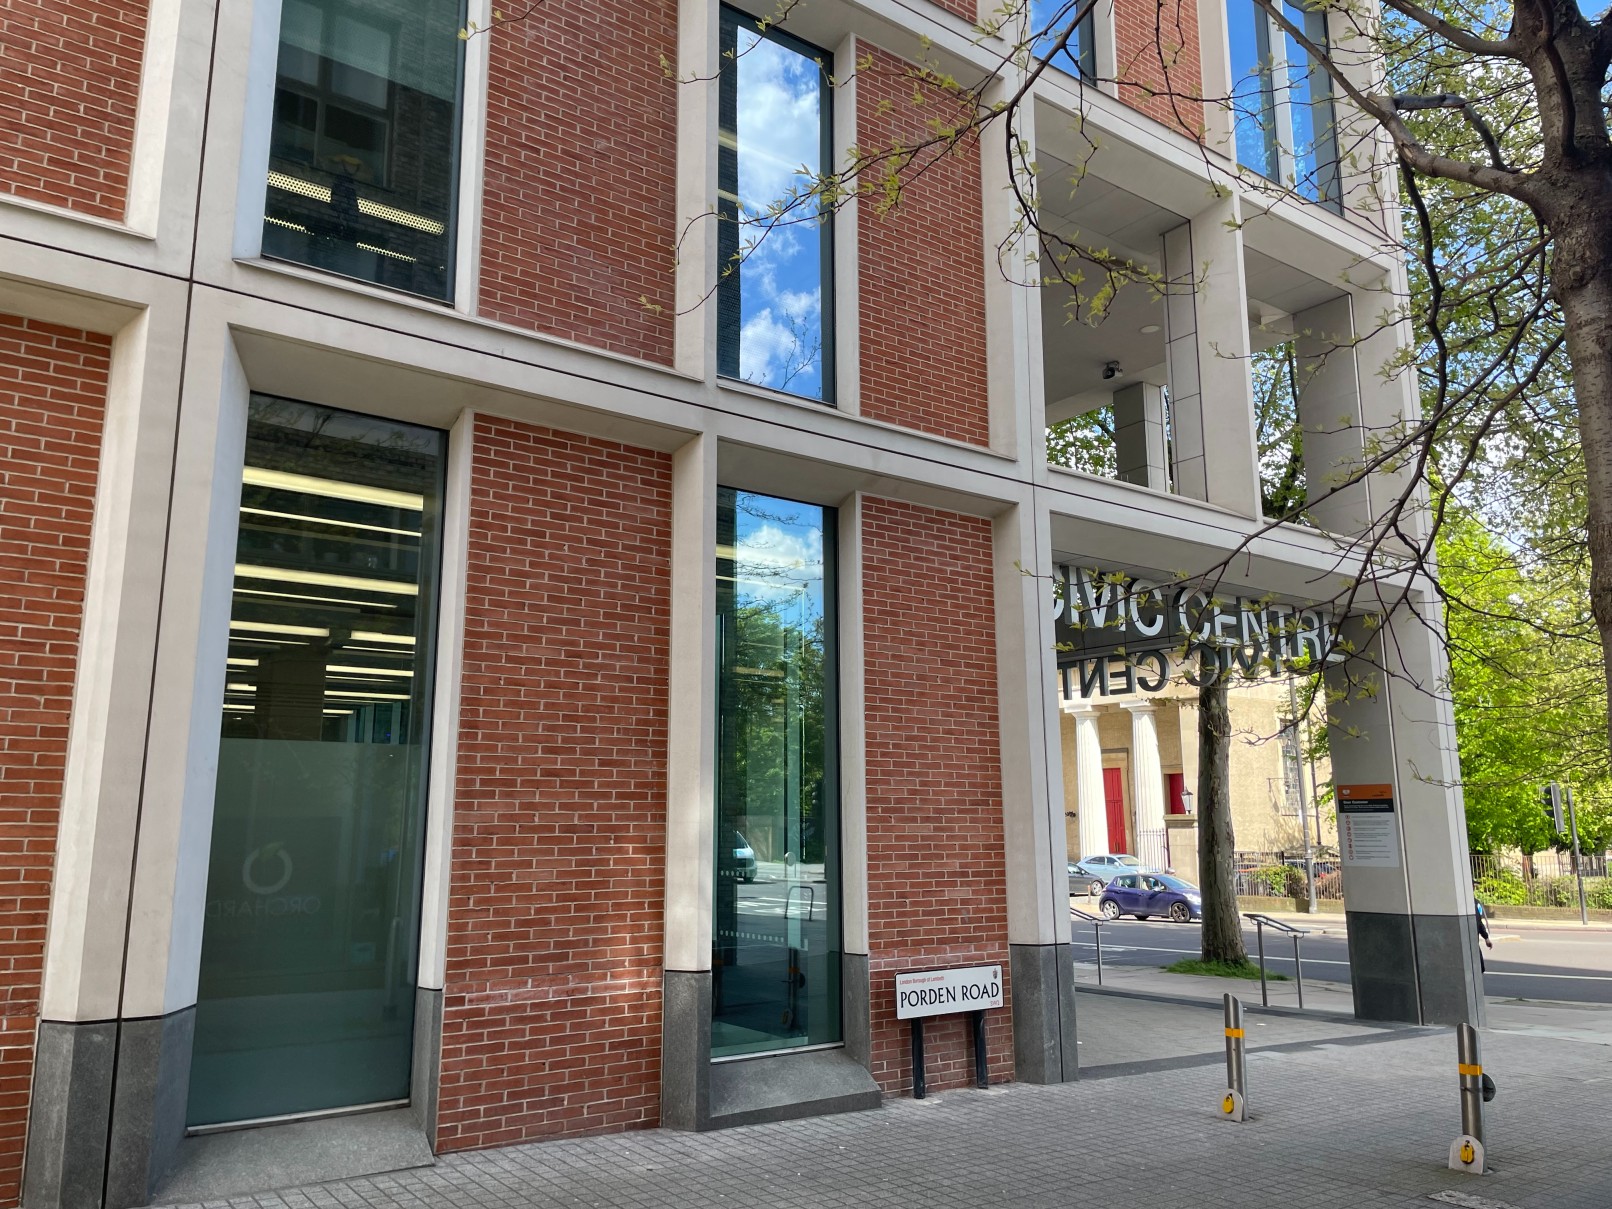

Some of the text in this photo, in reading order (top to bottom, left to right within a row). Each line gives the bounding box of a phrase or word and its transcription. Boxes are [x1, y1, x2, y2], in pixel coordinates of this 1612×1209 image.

[1178, 589, 1346, 662] CENTRE
[900, 982, 999, 1008] PORDEN ROAD
